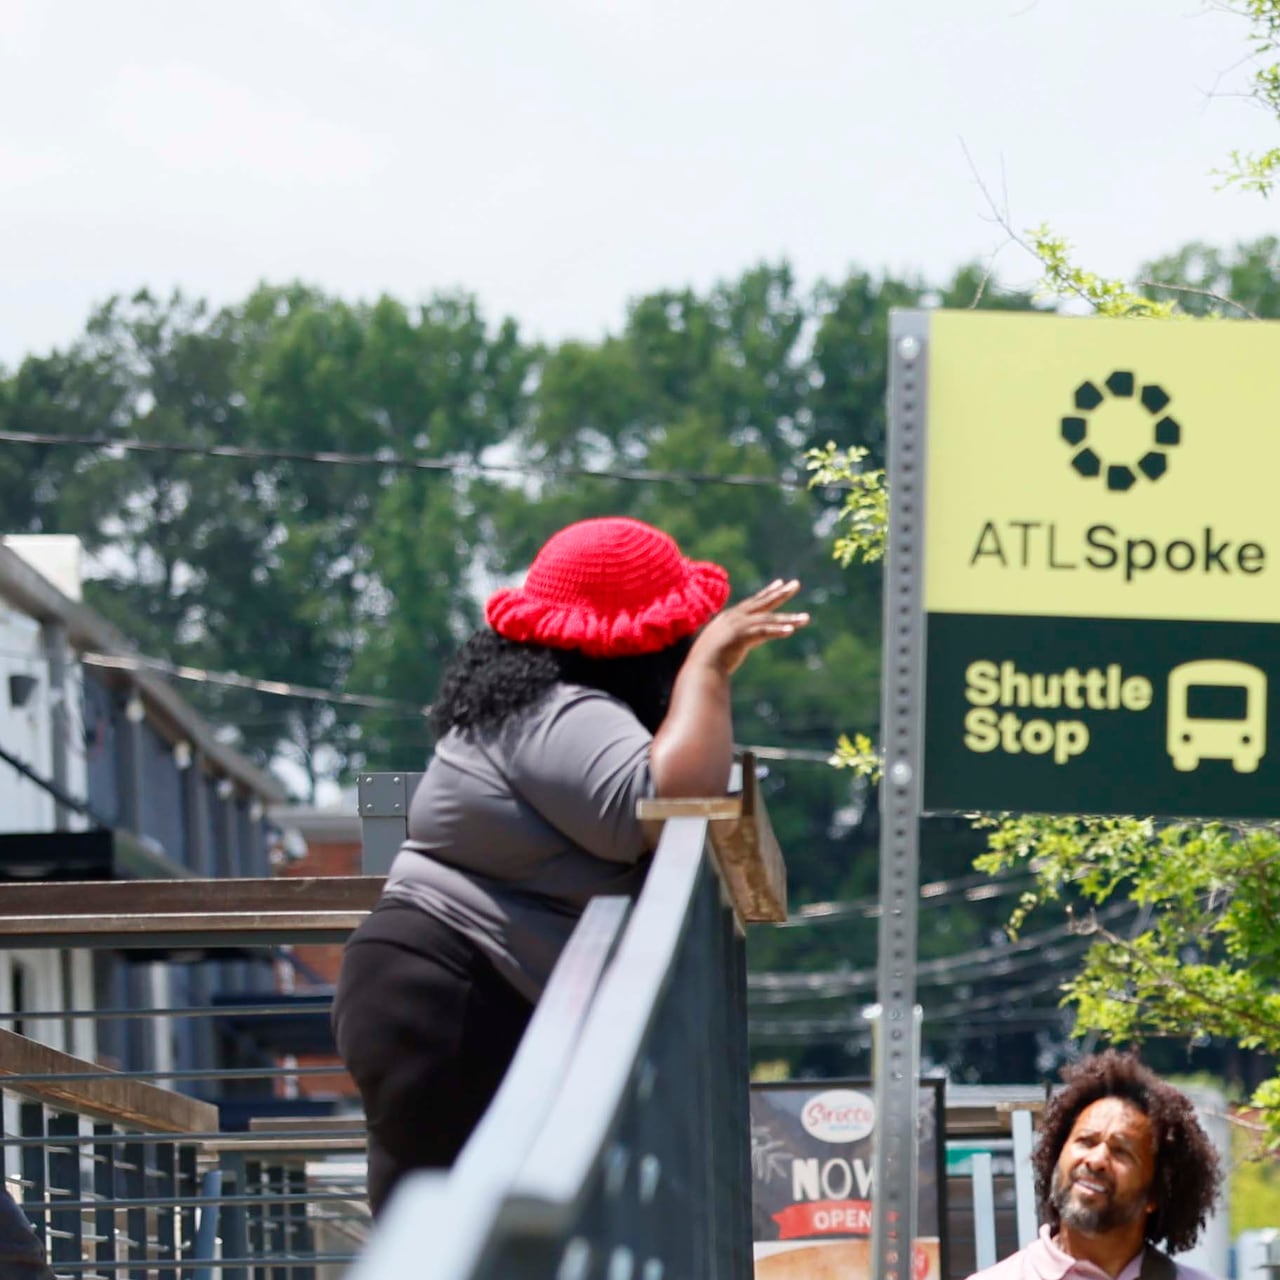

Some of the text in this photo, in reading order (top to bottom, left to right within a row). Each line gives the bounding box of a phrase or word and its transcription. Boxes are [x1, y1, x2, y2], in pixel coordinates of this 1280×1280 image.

[970, 520, 1266, 583] ATLSpoke
[964, 660, 1154, 711] Shuttle
[964, 707, 1090, 765] Stop
